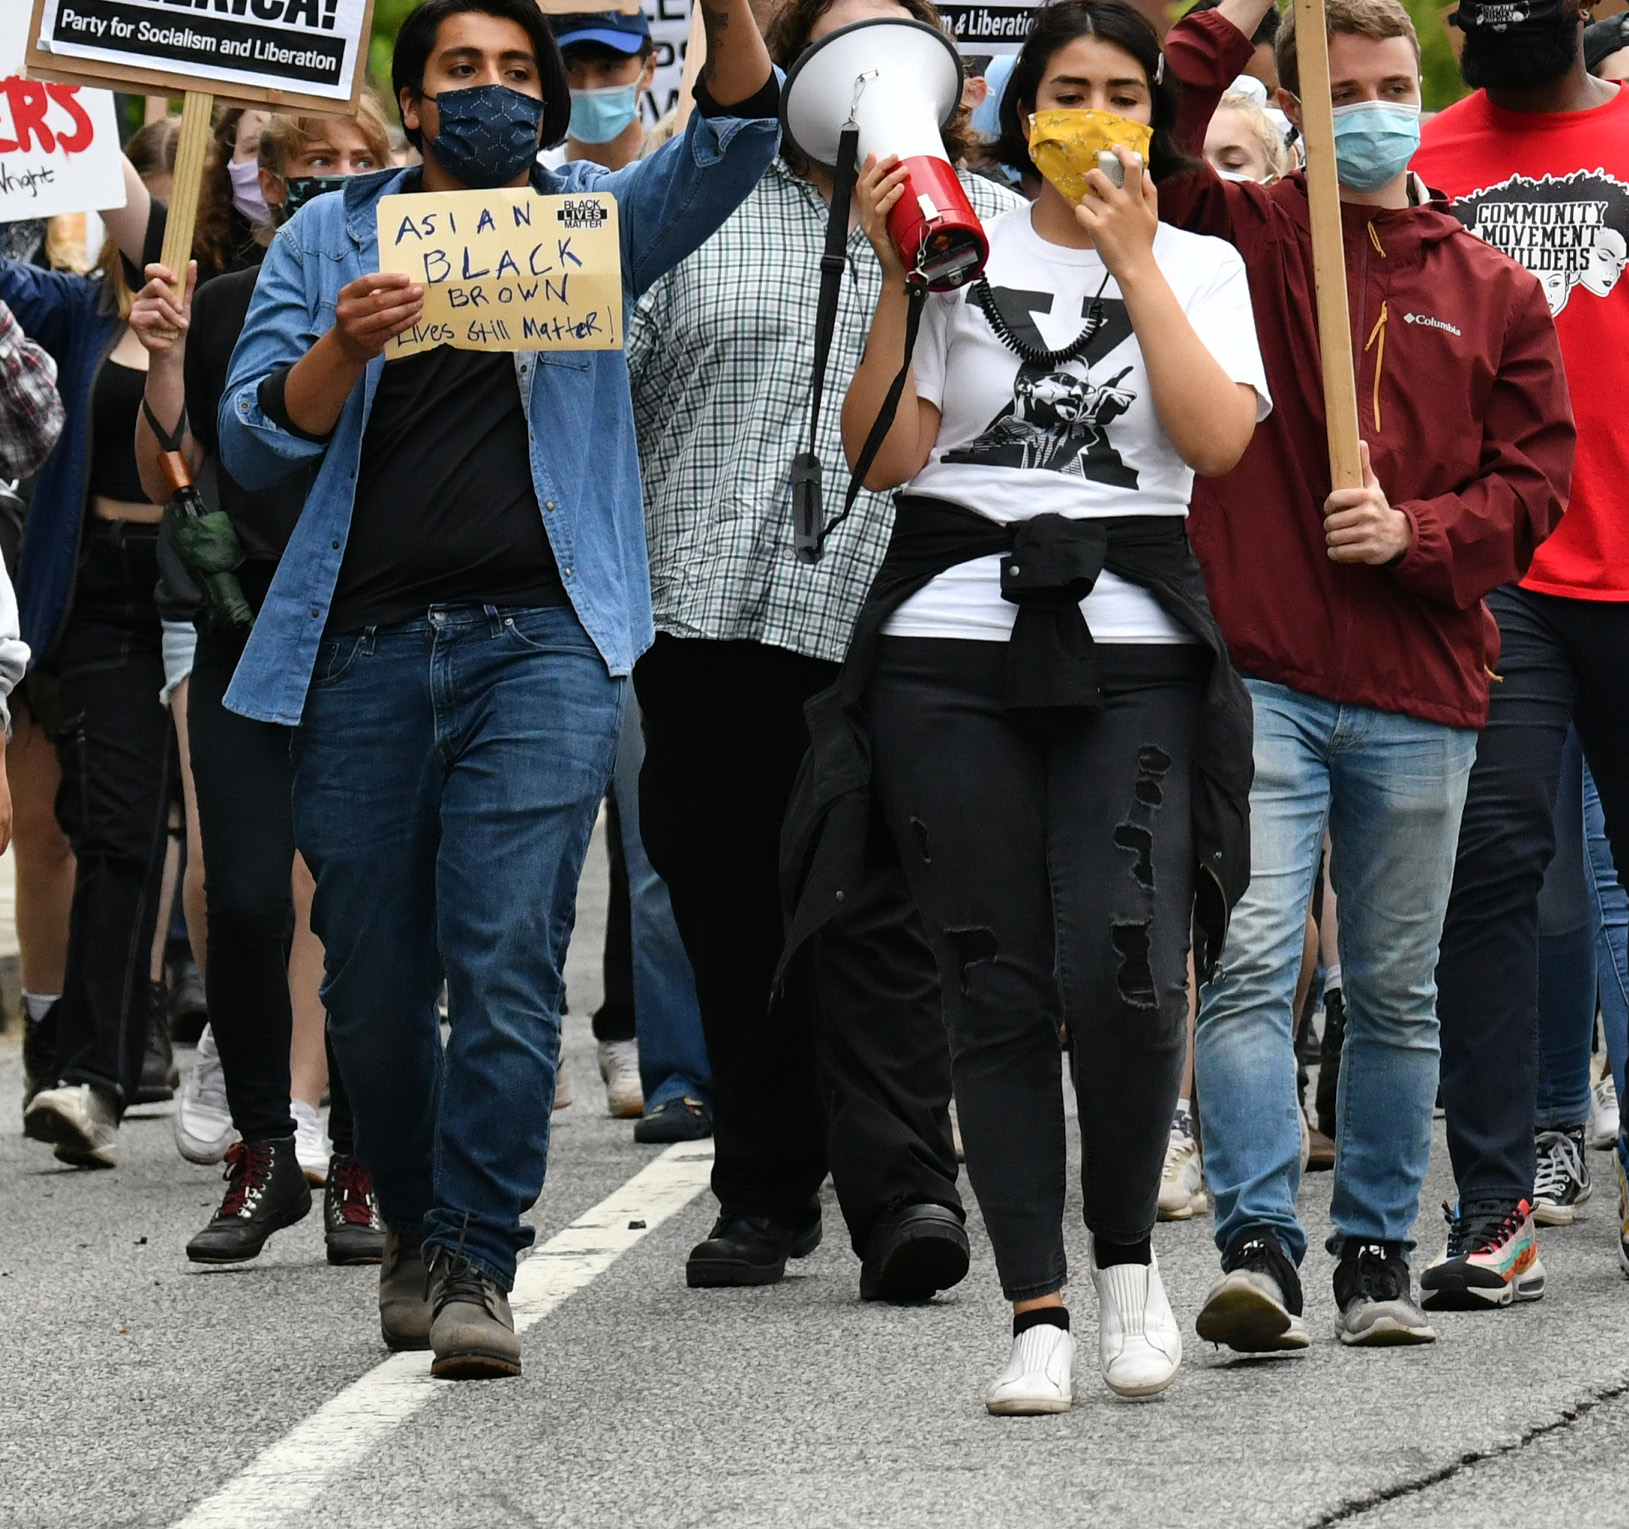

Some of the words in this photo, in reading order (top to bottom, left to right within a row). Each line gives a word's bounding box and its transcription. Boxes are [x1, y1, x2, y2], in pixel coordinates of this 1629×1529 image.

[955, 12, 967, 35] &
[968, 9, 1036, 37] Liberatio
[61, 8, 108, 37] Party
[110, 16, 136, 39] for
[137, 21, 217, 53] Socialism
[219, 35, 251, 57] and
[254, 38, 337, 72] Liberation
[563, 199, 601, 211] BLACK
[563, 210, 602, 220] LIVES
[1477, 202, 1608, 224] COMMUNITY
[395, 200, 532, 246] ASIAN
[563, 219, 602, 229] MATTER
[1482, 224, 1600, 248] MOVEMENT
[423, 236, 583, 289] BLACK
[448, 273, 569, 309] BROWN
[1415, 313, 1462, 337] Columbia
